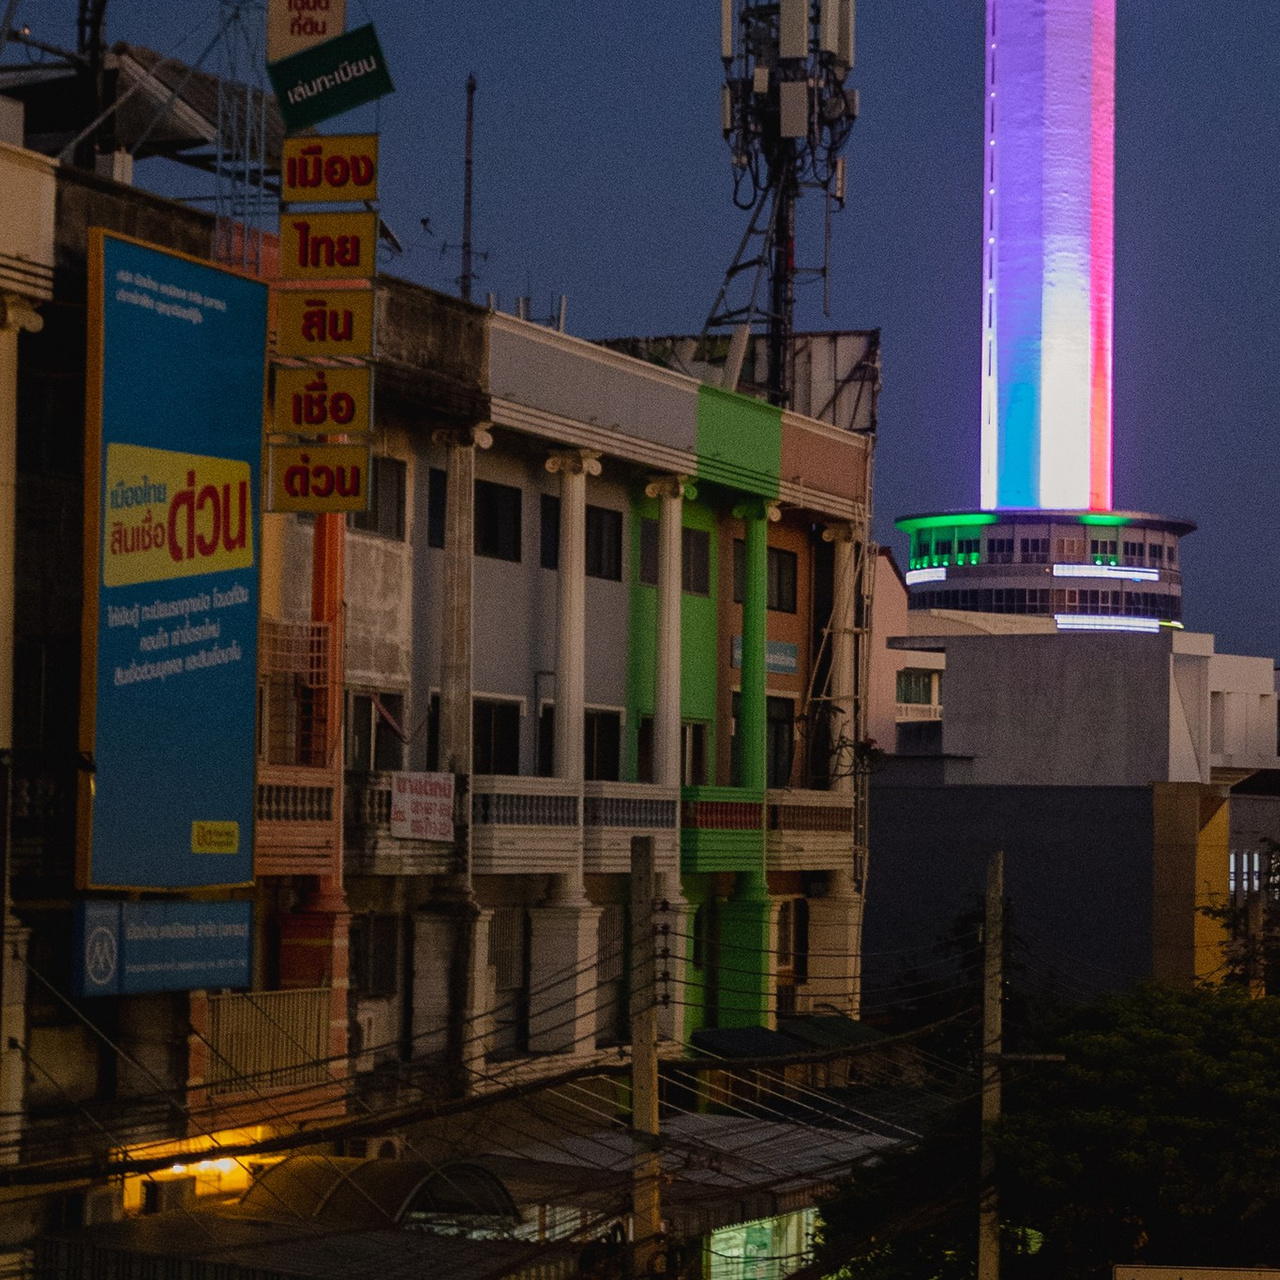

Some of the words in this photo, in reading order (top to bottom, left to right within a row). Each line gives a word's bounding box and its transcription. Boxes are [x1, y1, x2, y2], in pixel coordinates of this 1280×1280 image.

[290, 10, 326, 35] ที่ดิน
[287, 55, 377, 104] เล่มทะเบียน
[287, 145, 374, 188] เมือง
[293, 222, 360, 267] ไทย
[302, 299, 354, 342] สิน
[292, 371, 355, 424] เชื่อ
[110, 475, 167, 509] เมืองไทย
[284, 454, 360, 497] ด่วน
[111, 510, 166, 555] สินเชื่อ
[168, 469, 247, 562] ด่วน
